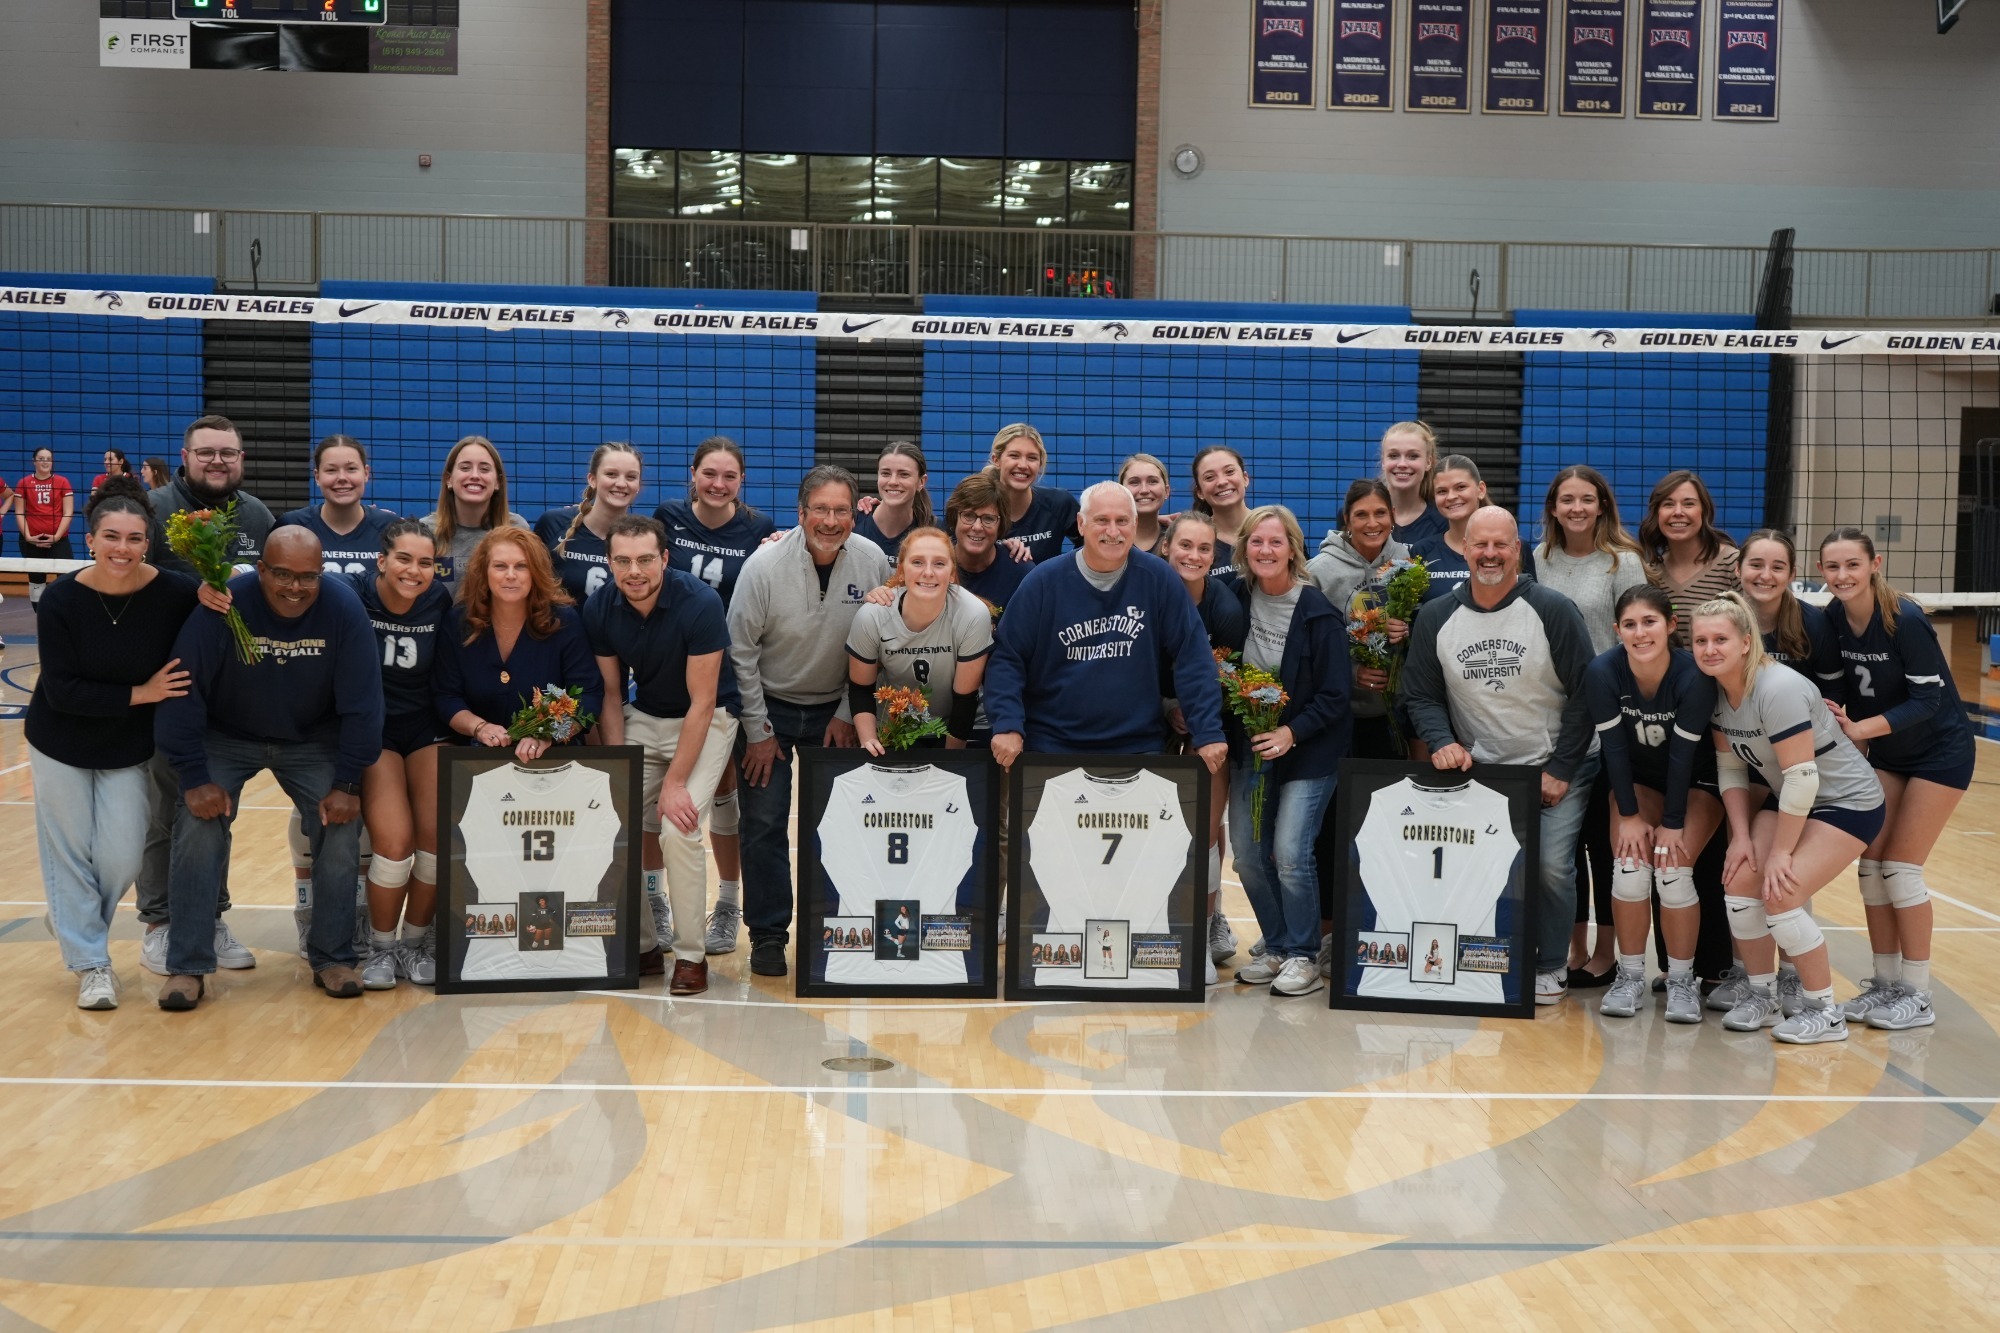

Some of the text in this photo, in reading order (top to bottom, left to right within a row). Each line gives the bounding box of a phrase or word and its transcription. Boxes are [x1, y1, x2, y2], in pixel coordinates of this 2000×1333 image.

[221, 9, 239, 18] TOL
[320, 12, 338, 20] TOL
[406, 29, 427, 39] Auto
[1262, 18, 1304, 38] NAIA
[1340, 21, 1382, 39] NAIA
[1418, 23, 1459, 42] NAIA
[1496, 25, 1537, 44] NAIA
[131, 34, 187, 46] FIRST
[1574, 27, 1614, 46] NAIA
[1650, 30, 1691, 48] NAIA
[1727, 31, 1768, 50] NAIA
[1258, 61, 1309, 69] BASKETBALL
[1335, 63, 1387, 71] BASKETBALL
[1343, 56, 1380, 64] WOMEN'S
[1413, 65, 1464, 73] BASKETBALL
[1491, 67, 1541, 75] BASKETBALL
[1644, 71, 1695, 79] BASKETBALL
[1265, 91, 1299, 101] 2001
[1343, 93, 1379, 103] 2002
[1420, 96, 1457, 105] 2002
[1498, 97, 1534, 107] 2003
[1576, 100, 1611, 109] 2014
[1653, 102, 1686, 111] 2017
[1730, 104, 1762, 113] 2021
[147, 296, 314, 314] GOLDEN EAGLES
[410, 305, 575, 322] GOLDEN EAGLES
[654, 314, 819, 330] GOLDEN EAGLES
[911, 321, 1075, 337] GOLDEN EAGLES
[1152, 326, 1313, 340] GOLDEN EAGLES
[1404, 330, 1564, 344] GOLDEN EAGLES
[1640, 333, 1799, 347] GOLDEN EAGLES
[1887, 336, 1965, 349] GOLDEN
[37, 492, 50, 504] 15
[675, 537, 746, 557] CORNERSTONE
[690, 554, 724, 588] 14
[585, 566, 608, 597] 6
[847, 584, 864, 599] CU
[1126, 605, 1145, 619] CU
[370, 619, 434, 633] ORNERSTONE
[1058, 614, 1145, 646] CORNERSTONE
[384, 635, 417, 669] 13
[885, 645, 952, 655] CORNERSTONE
[1067, 640, 1133, 661] UNIVERSITY
[1456, 639, 1527, 663] CORNERSTONE
[912, 658, 930, 686] 8
[1463, 665, 1521, 680] UNIVERSITY
[1854, 665, 1875, 697] 2
[1621, 706, 1677, 721] ORNRSTON
[1731, 741, 1764, 768] 10
[503, 810, 575, 826] CORNERSTONE
[864, 812, 933, 829] CORNERSTONE
[1077, 813, 1149, 829] CORNERSTONE
[1403, 825, 1475, 845] CORNERSTONE
[521, 830, 555, 861] 13
[888, 833, 909, 865] 8
[1101, 833, 1123, 865] 7
[1432, 846, 1443, 879] 1
